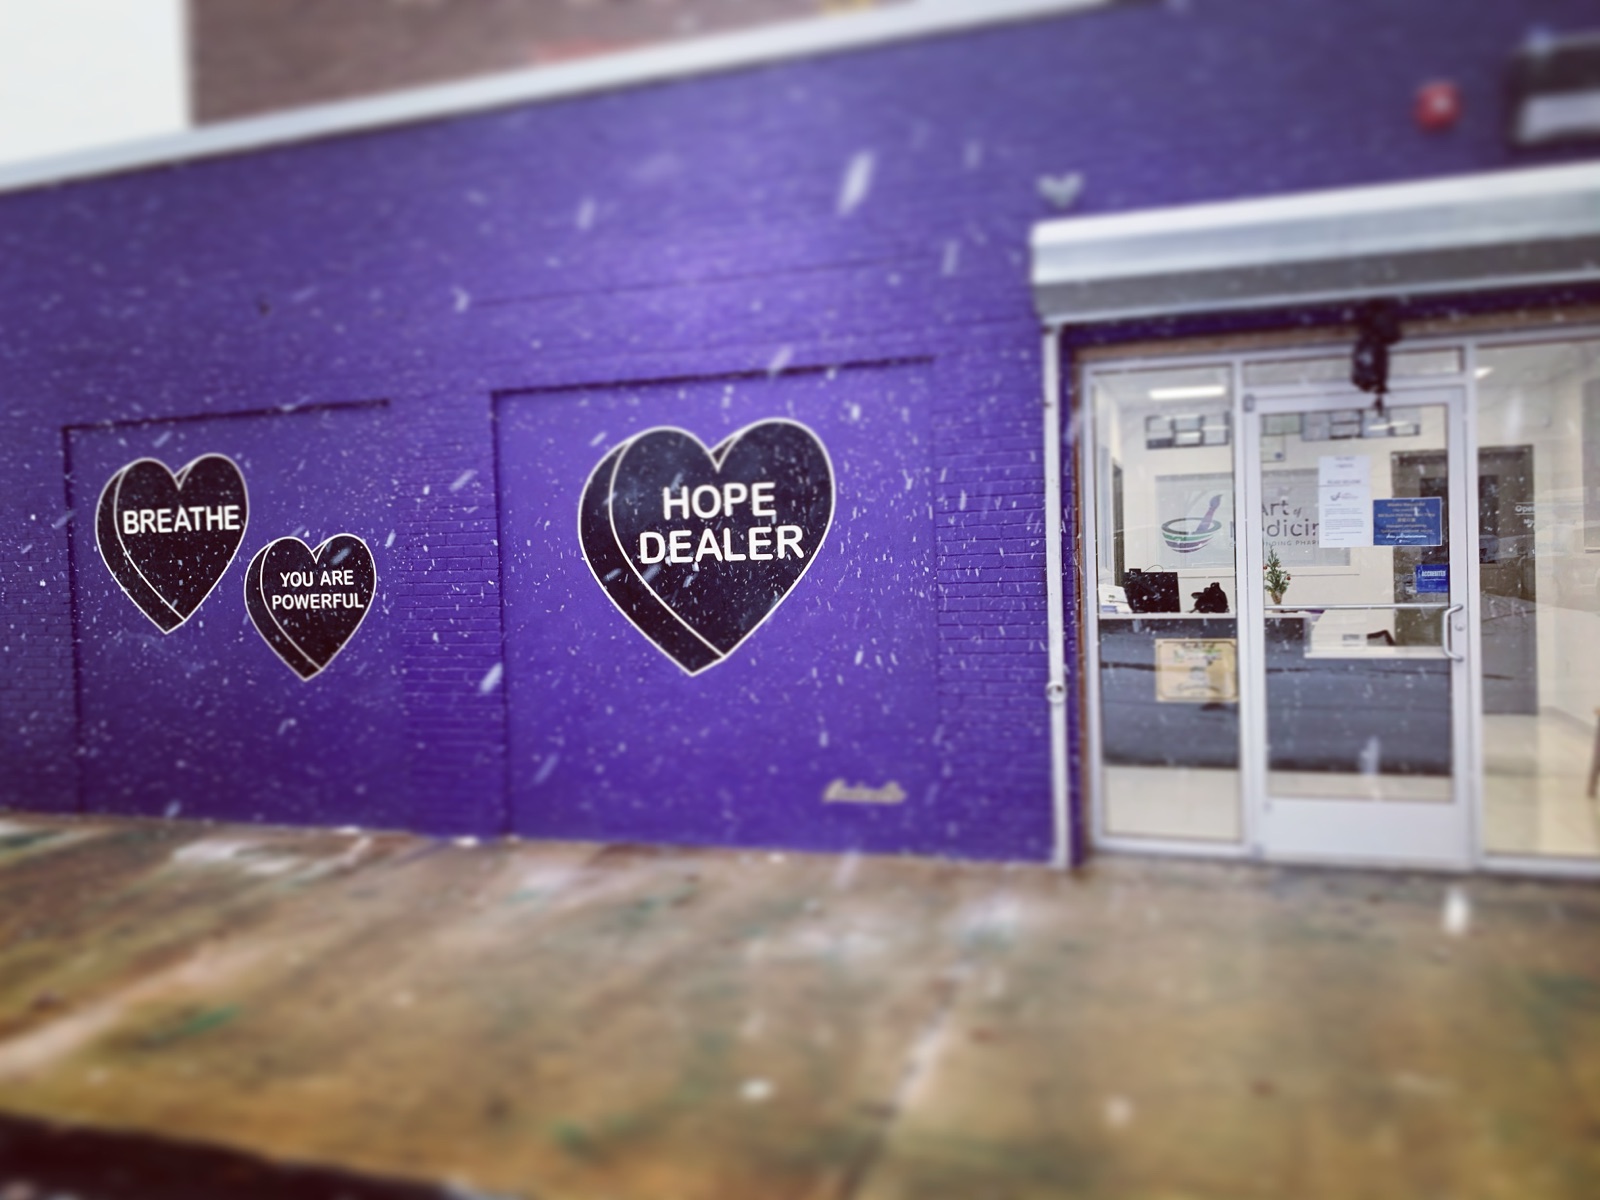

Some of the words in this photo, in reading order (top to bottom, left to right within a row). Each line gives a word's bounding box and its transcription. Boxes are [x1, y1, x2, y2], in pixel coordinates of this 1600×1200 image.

[663, 482, 777, 520] HOPE
[1515, 505, 1535, 513] Ope
[123, 505, 240, 534] BREATHE
[639, 525, 804, 564] DEALER
[280, 572, 314, 587] YOU
[320, 570, 354, 586] ARE
[272, 593, 364, 610] POWERFUL
